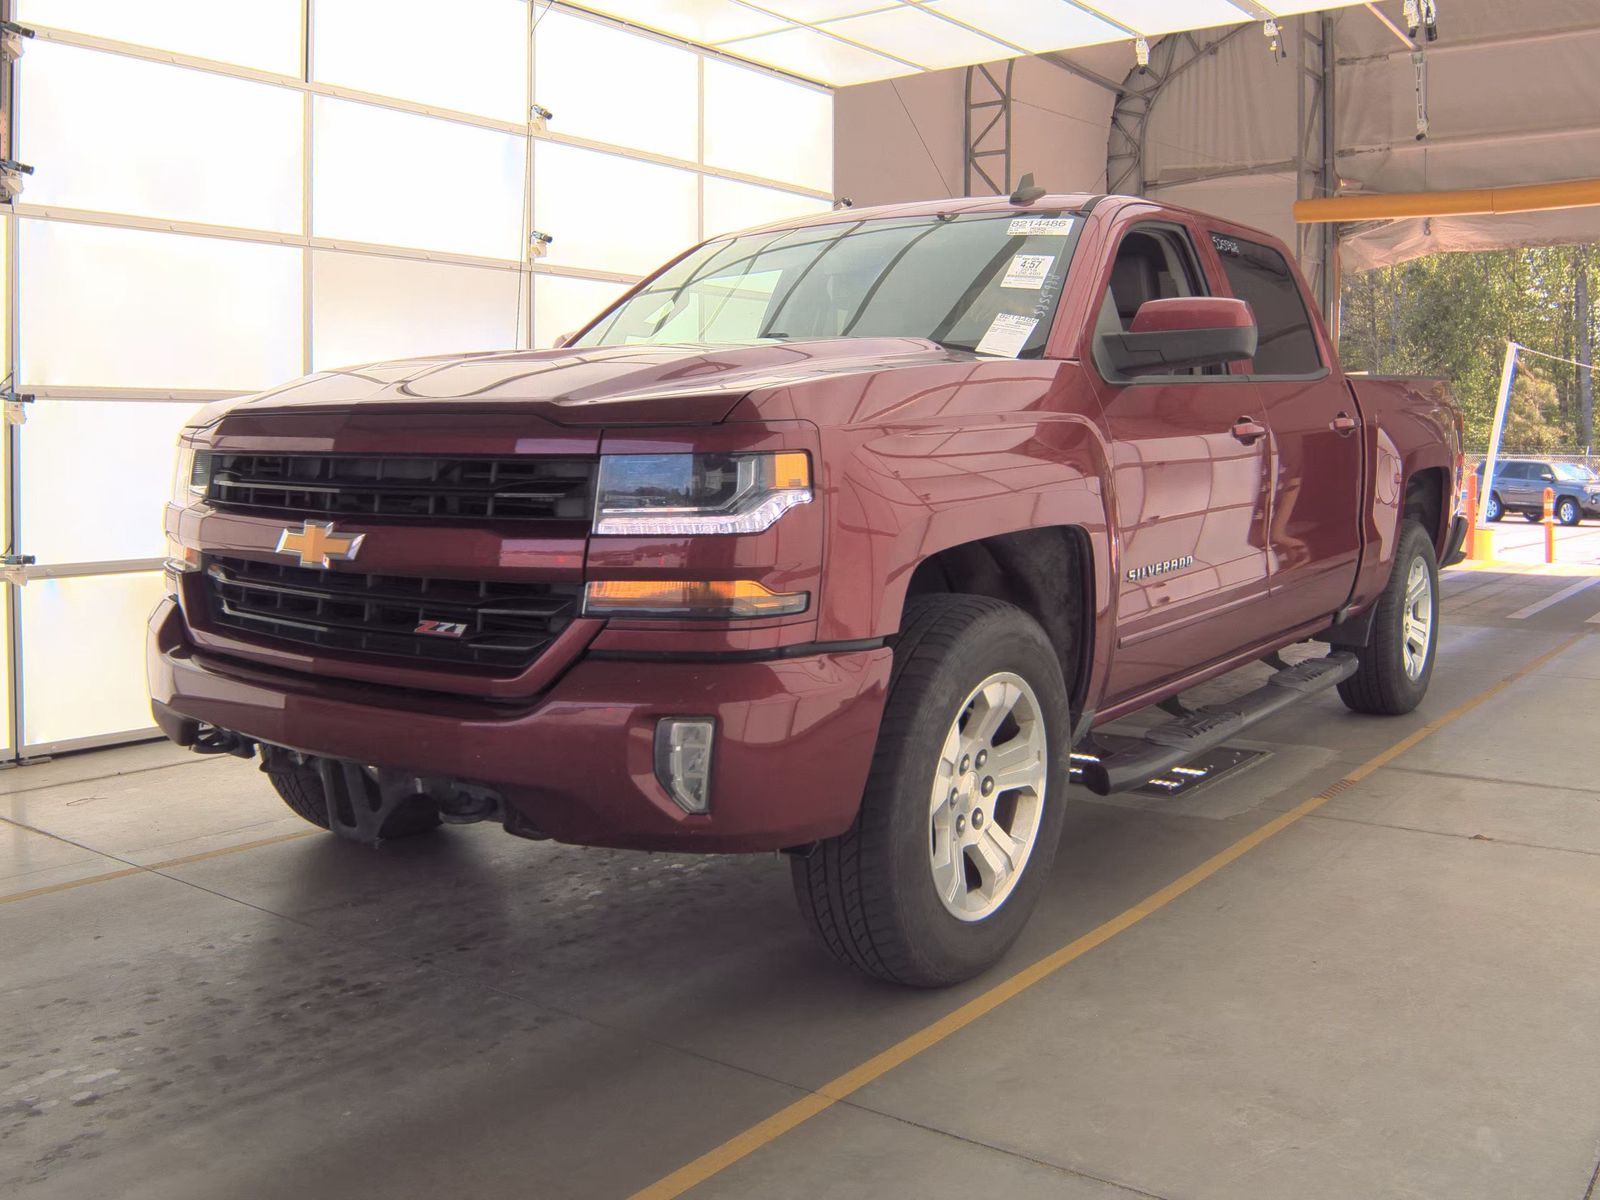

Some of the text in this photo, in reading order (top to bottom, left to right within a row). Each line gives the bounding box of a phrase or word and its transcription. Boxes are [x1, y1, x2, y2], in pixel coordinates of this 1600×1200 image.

[1020, 260, 1042, 270] 4:57
[1127, 555, 1193, 580] SILVERADO
[413, 619, 468, 638] Z71
